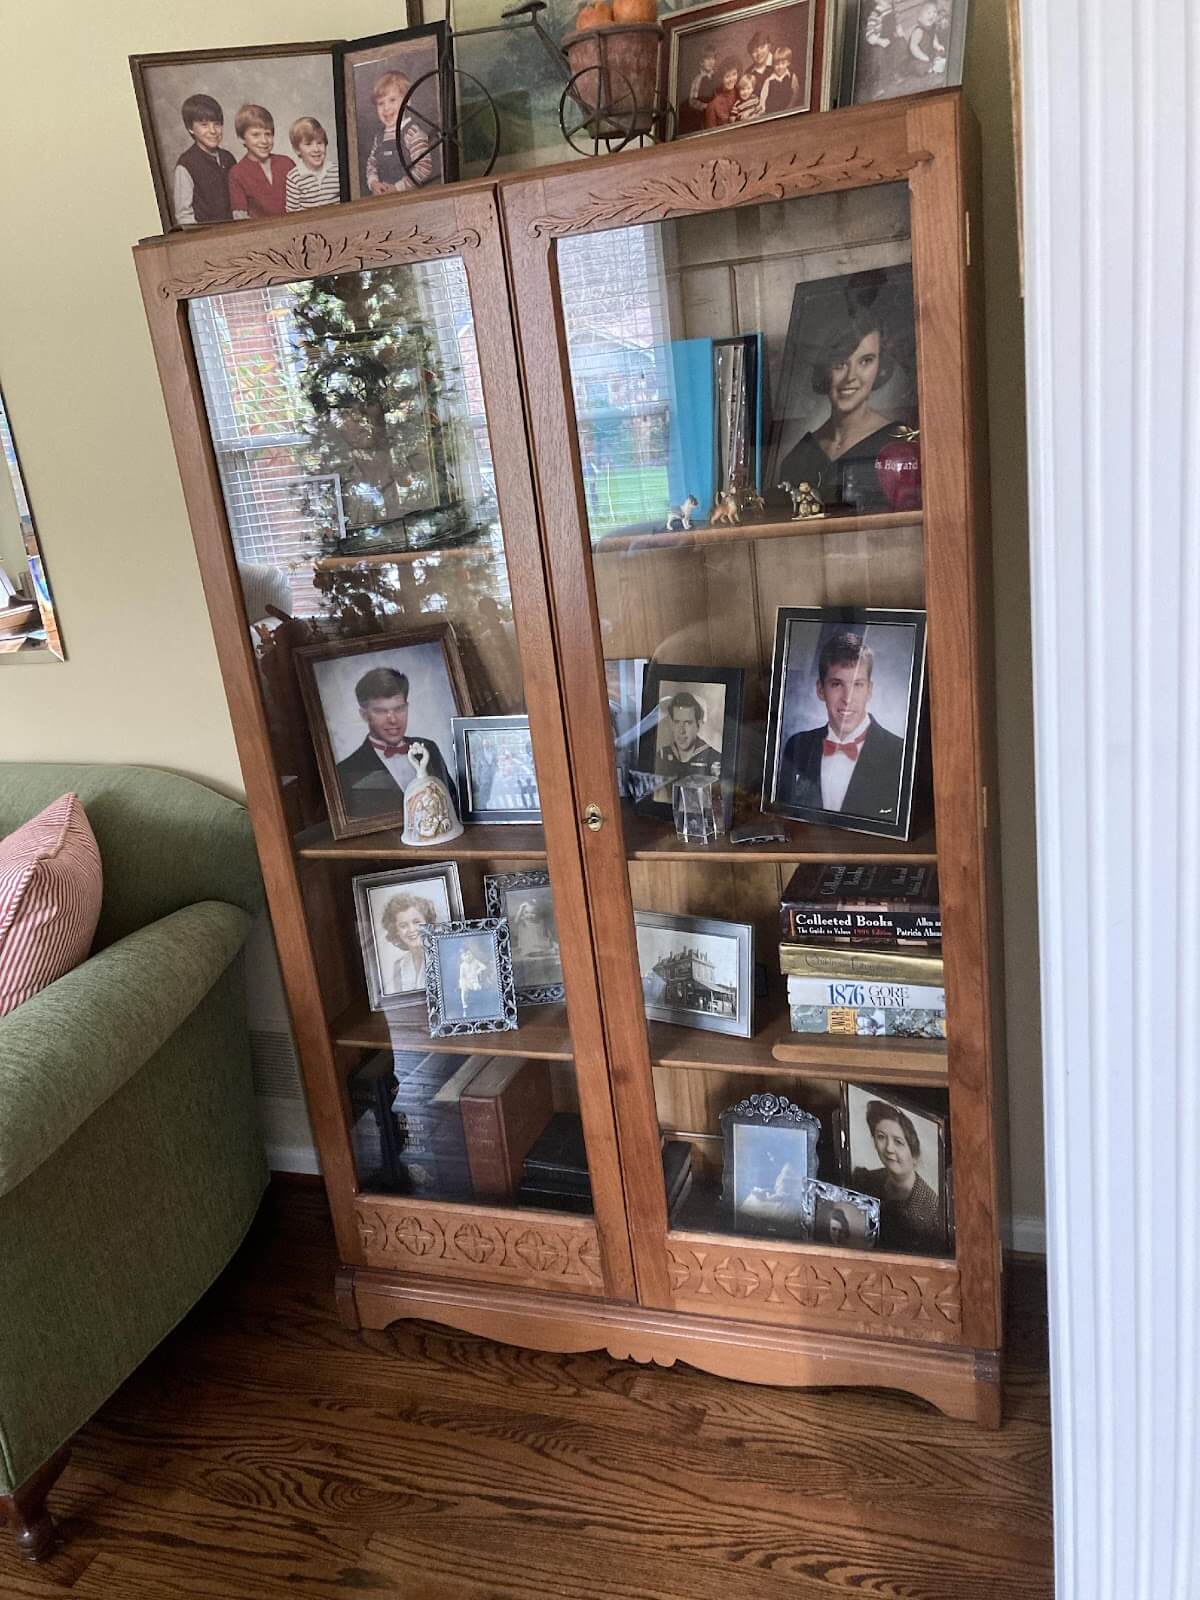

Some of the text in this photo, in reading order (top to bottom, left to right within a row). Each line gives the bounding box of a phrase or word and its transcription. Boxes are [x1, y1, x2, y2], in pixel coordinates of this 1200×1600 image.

[884, 459, 918, 470] Howard
[795, 913, 893, 927] Collected Books
[809, 927, 825, 935] Guide
[834, 927, 851, 936] Values
[896, 927, 922, 937] Patricia
[827, 983, 865, 1006] 1876
[868, 985, 909, 999] GORE
